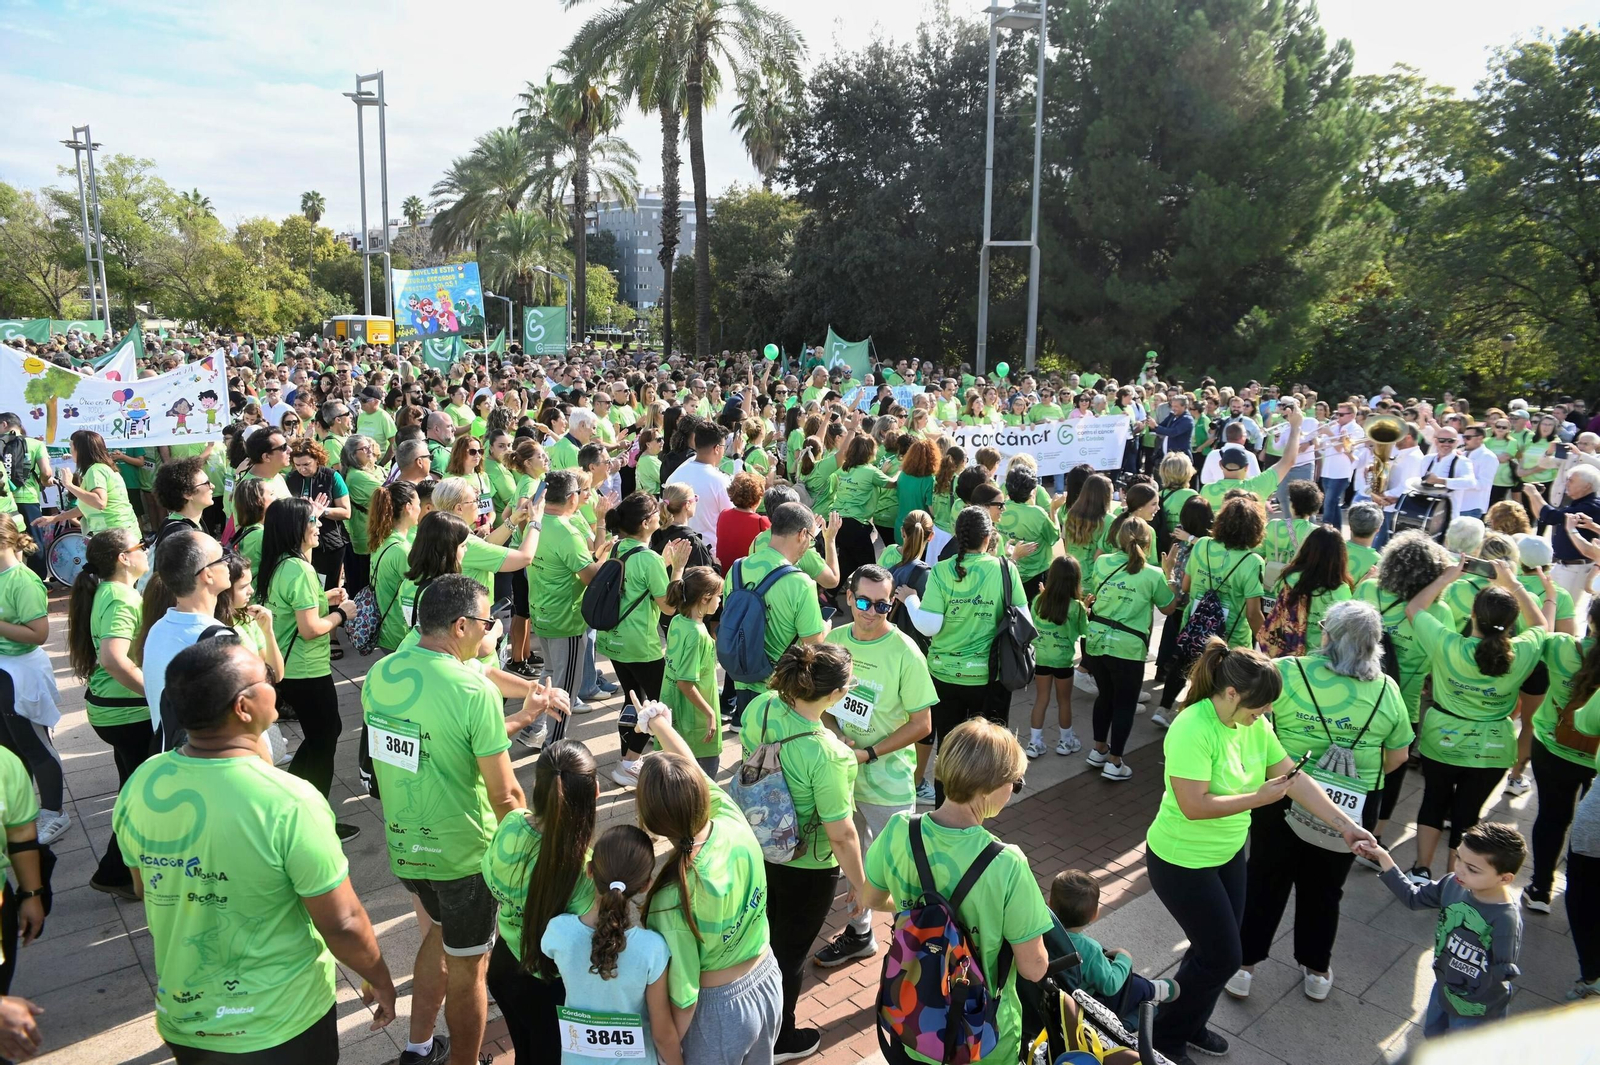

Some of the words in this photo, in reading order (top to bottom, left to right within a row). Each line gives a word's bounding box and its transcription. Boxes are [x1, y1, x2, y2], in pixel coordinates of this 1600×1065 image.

[844, 697, 868, 717] 3857
[386, 736, 414, 757] 3847
[1447, 936, 1488, 972] HULK
[562, 1009, 591, 1019] Córdoba
[586, 1029, 634, 1045] 3845
